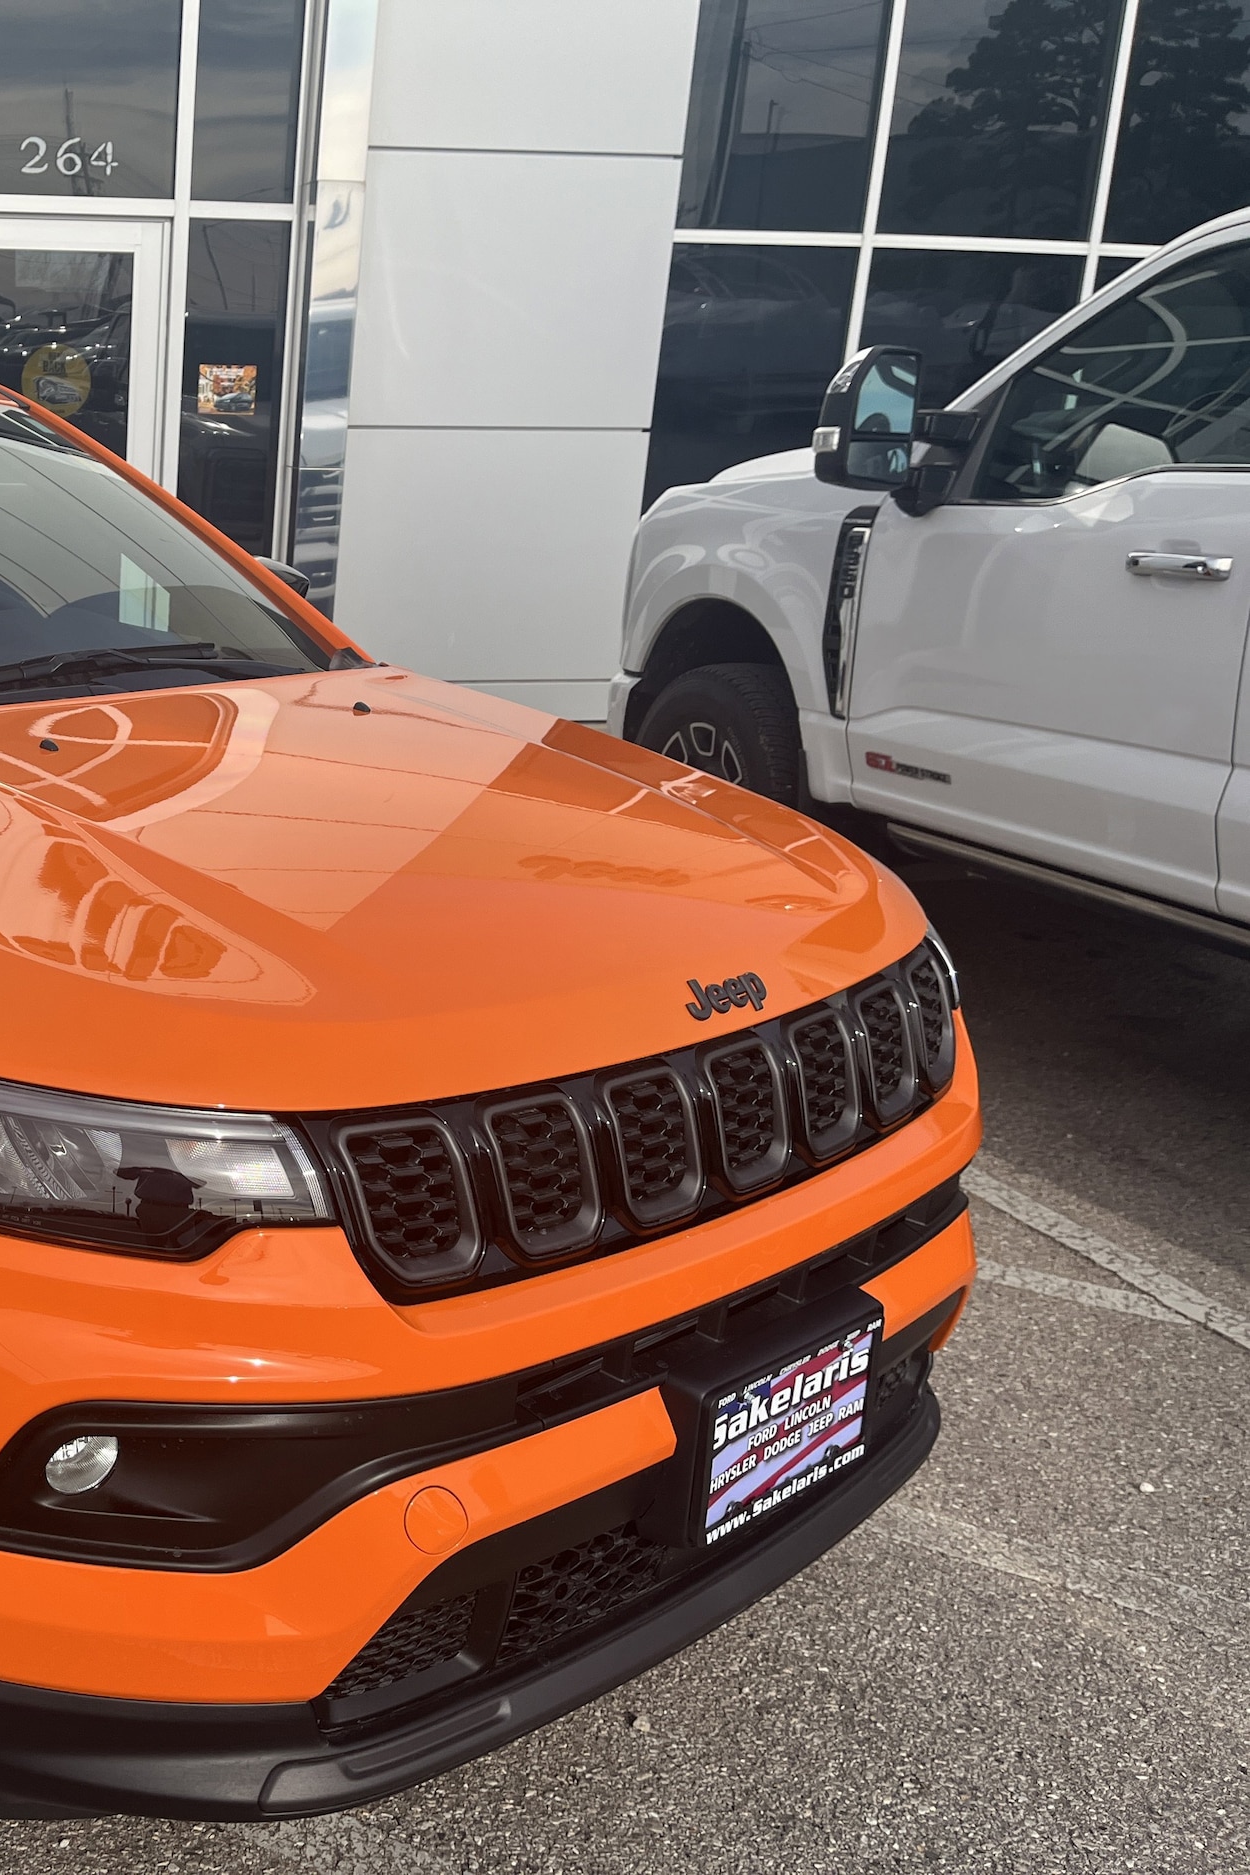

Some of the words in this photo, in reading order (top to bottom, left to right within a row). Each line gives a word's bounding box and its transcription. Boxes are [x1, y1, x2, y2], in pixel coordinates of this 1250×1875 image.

[19, 136, 119, 176] 264
[685, 972, 767, 1021] Jeep
[713, 1348, 870, 1450] Sakelaris
[718, 1392, 737, 1409] FORD
[743, 1374, 773, 1394] LINCOLN
[867, 1319, 882, 1332] RAM
[709, 1454, 757, 1494] HRYSLER
[763, 1429, 802, 1461] DODGE
[807, 1413, 834, 1437] JEEP
[838, 1398, 865, 1421] RAM
[747, 1423, 778, 1451] FORD
[784, 1394, 831, 1431] LINCOLN
[706, 1444, 865, 1545] www.Sakelaris.com
